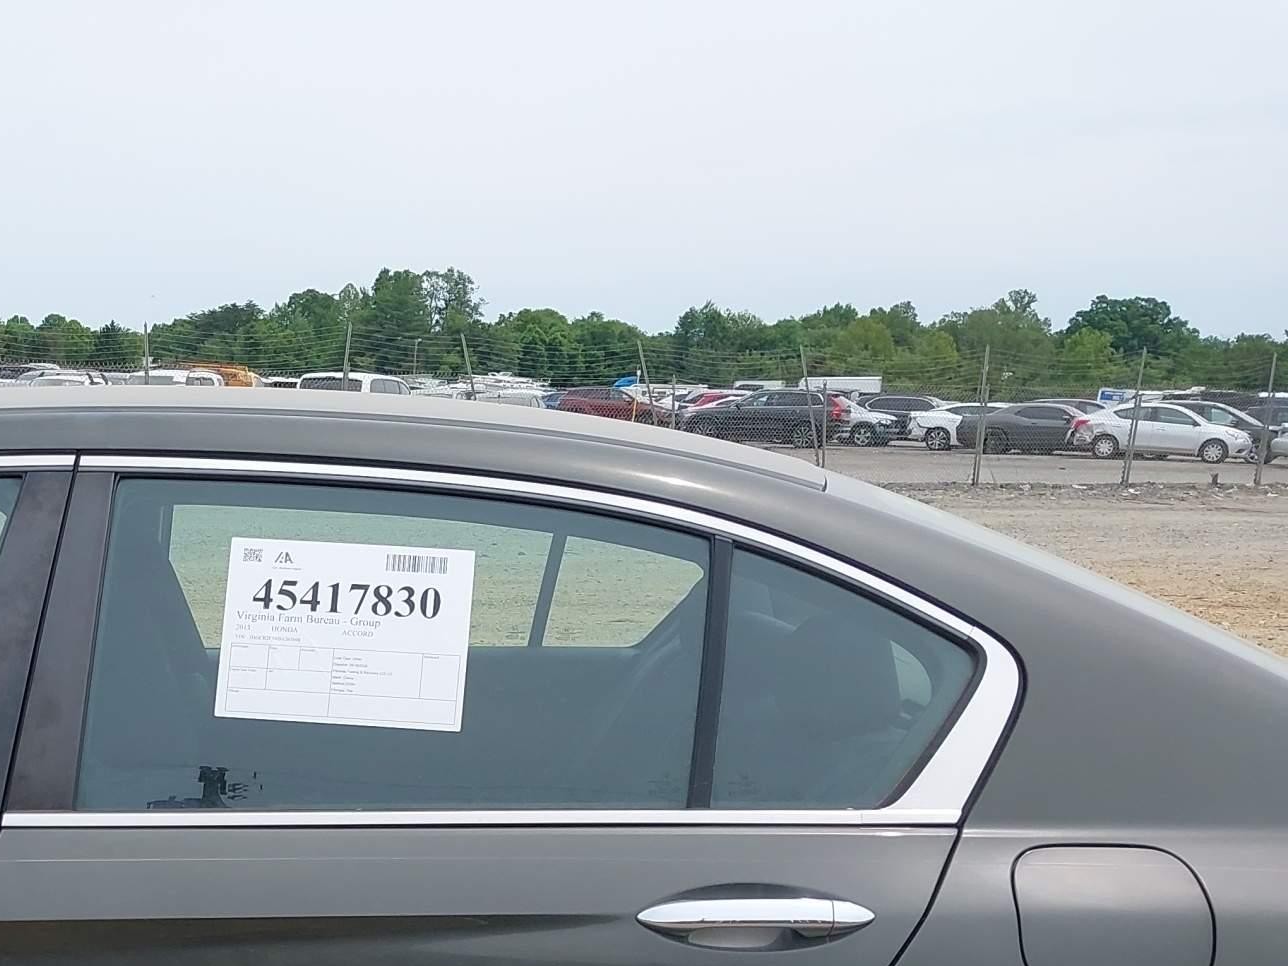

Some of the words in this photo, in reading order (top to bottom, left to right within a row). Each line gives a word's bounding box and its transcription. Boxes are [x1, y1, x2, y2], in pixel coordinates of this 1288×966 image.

[252, 577, 442, 619] 45417830
[237, 610, 275, 623] Virginia
[278, 613, 303, 622] Farm
[306, 614, 340, 625] Bureau
[350, 617, 381, 629] Group
[271, 625, 298, 633] HONDA
[342, 629, 374, 638] ACCORD
